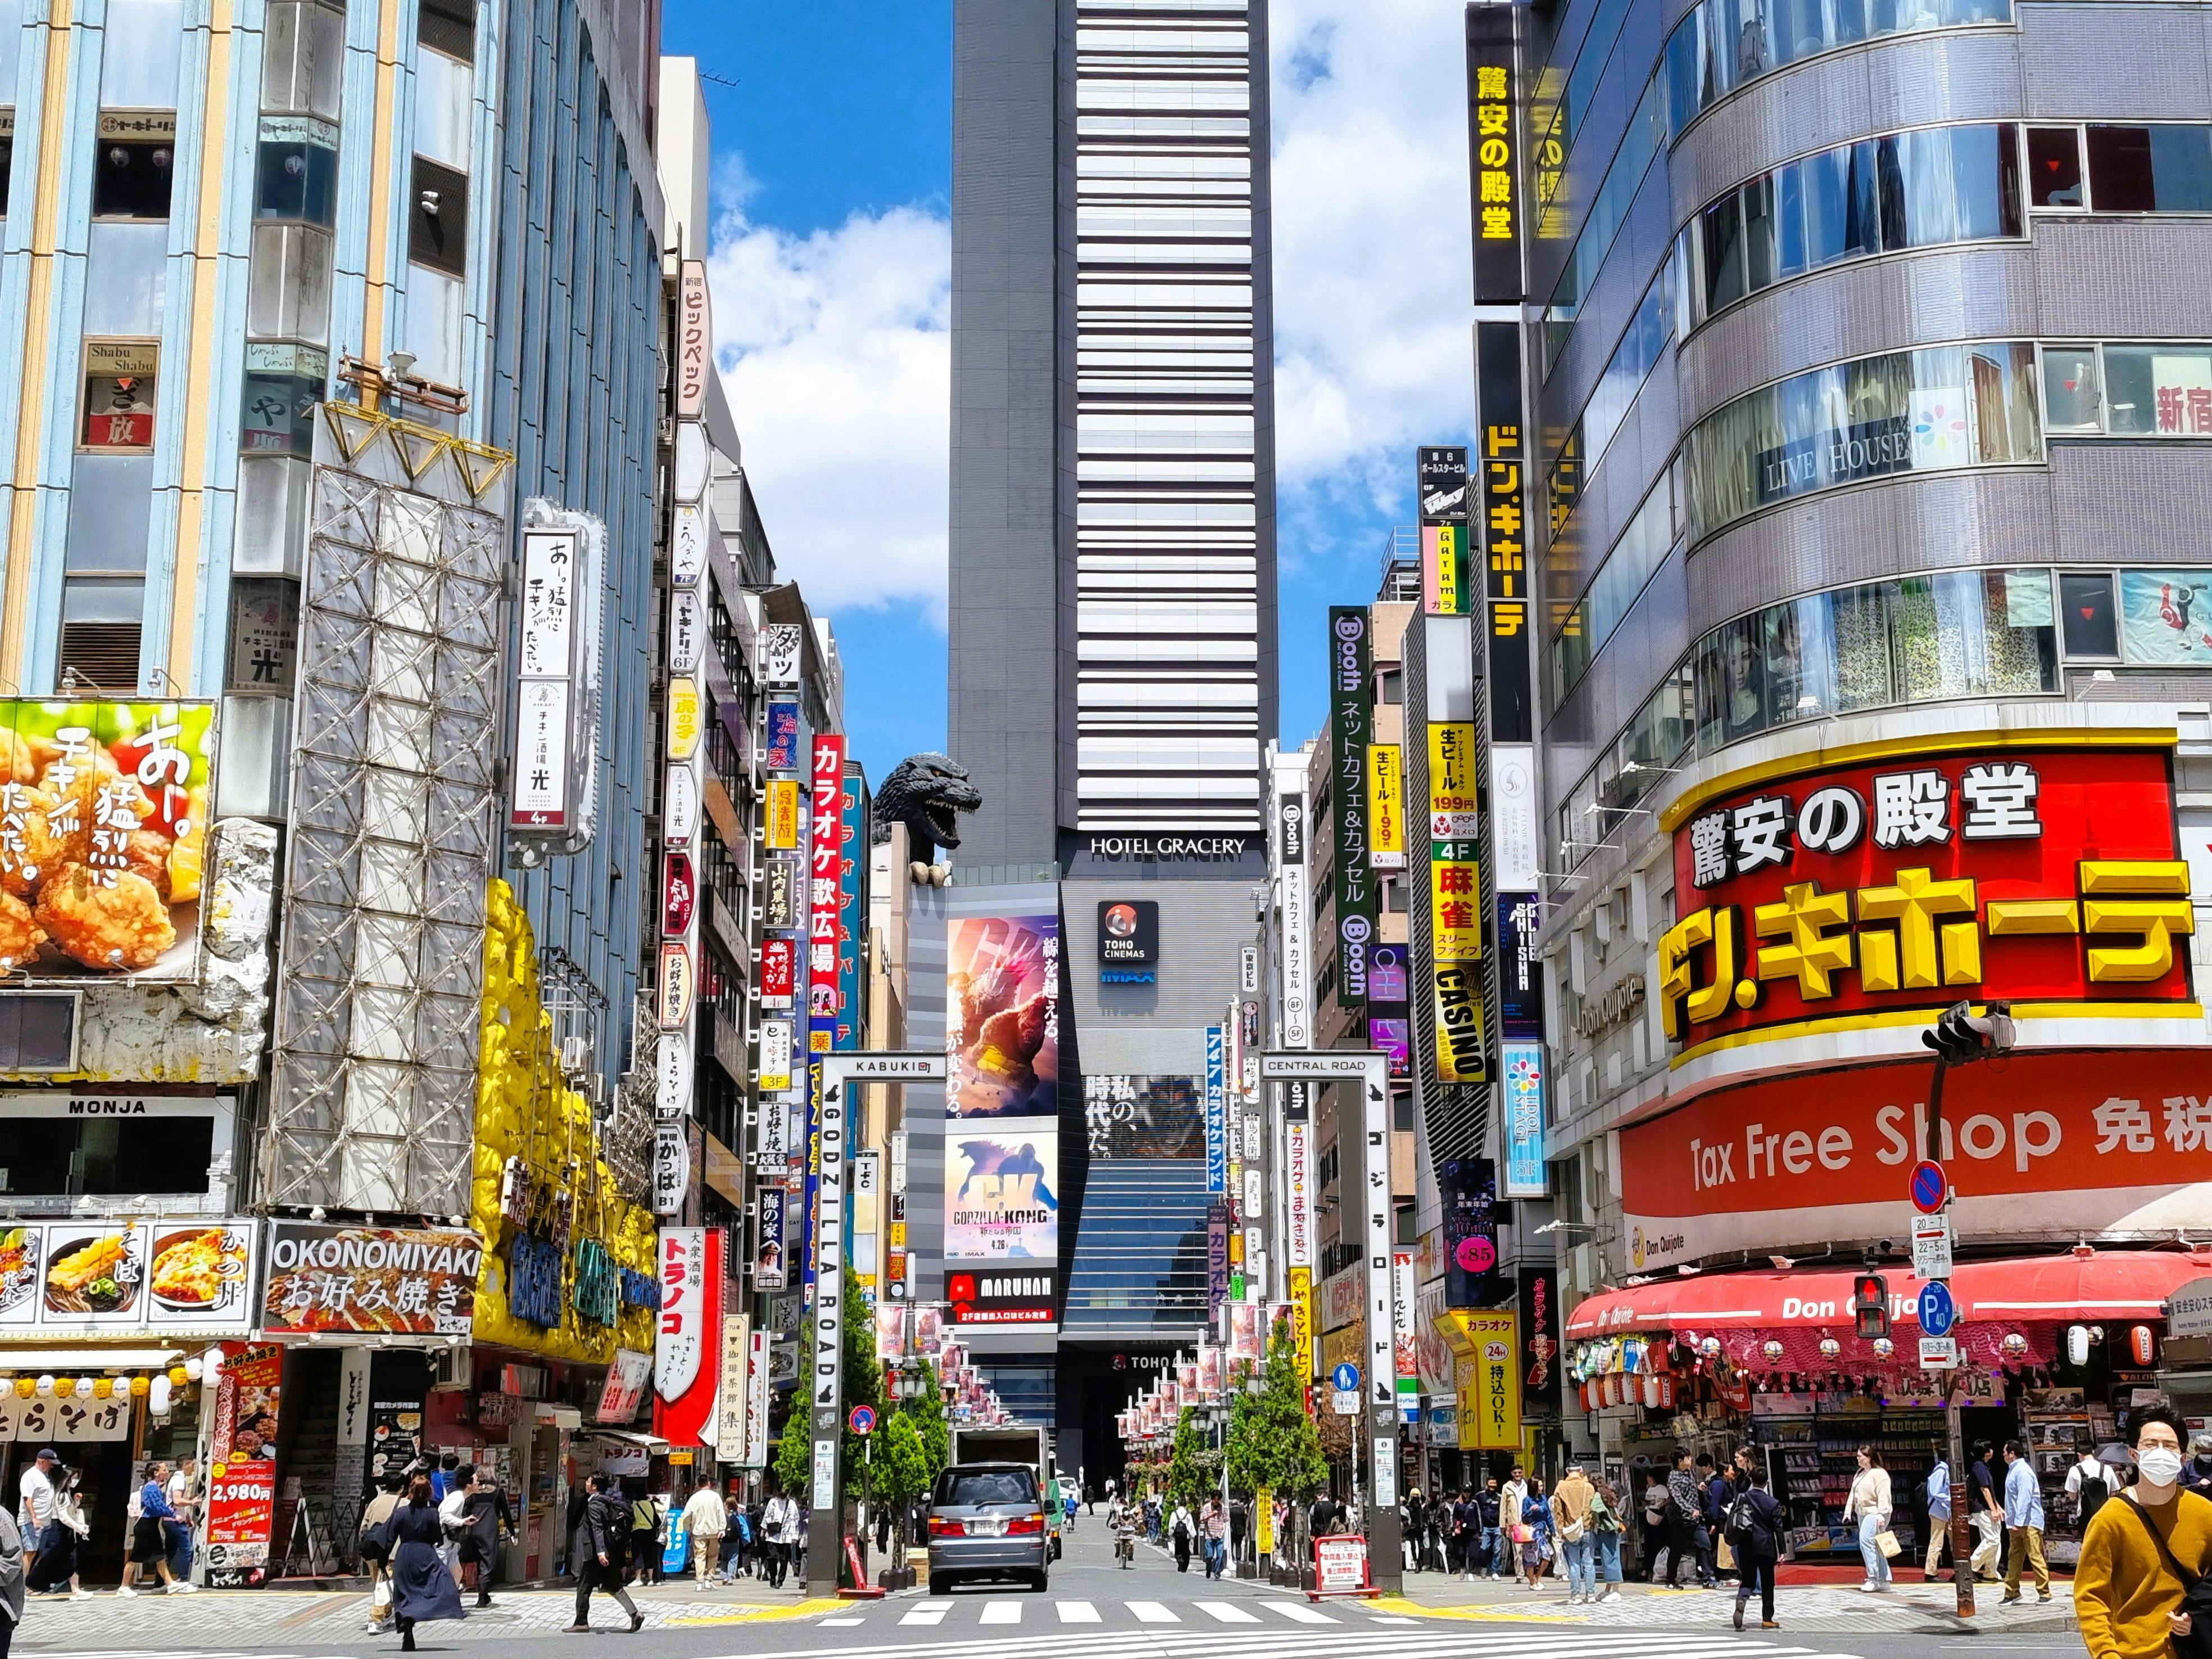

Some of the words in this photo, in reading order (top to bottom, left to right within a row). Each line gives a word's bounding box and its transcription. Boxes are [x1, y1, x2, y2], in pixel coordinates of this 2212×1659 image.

[1477, 66, 1512, 238] 驚安の殿堂
[685, 277, 702, 287] 新宿
[92, 346, 130, 358] Shabu
[115, 360, 153, 371] Shabu
[683, 293, 703, 399] ピックペック
[251, 395, 287, 427] や
[1766, 451, 1815, 492] LIVE
[1829, 432, 1909, 474] HOUSE
[1440, 532, 1455, 595] Garam
[1431, 600, 1462, 610] ガラム
[678, 606, 692, 649] ヤキトリ
[251, 649, 283, 684] 光
[526, 630, 543, 673] たべたい。
[674, 657, 693, 668] 6F
[774, 628, 795, 677] ダーツ
[674, 700, 696, 739] 虎の子
[767, 713, 797, 768] 海の家
[132, 714, 191, 838] あー。
[531, 769, 550, 790] 光
[1376, 751, 1389, 801] 生ビール
[1440, 729, 1456, 791] 生ビール
[47, 727, 90, 838] チキンが
[1341, 701, 1366, 902] ネットカフェ&カプセル
[1433, 796, 1474, 810] 199円
[1, 780, 38, 881] たべたい。
[89, 782, 143, 889] 猛烈に
[531, 811, 548, 824] 4F
[1380, 804, 1391, 847] 199円
[1690, 762, 2043, 888] 驚安の殿堂
[812, 744, 838, 973] カラオケ歌広場
[1091, 838, 1153, 854] HOTEL
[1157, 838, 1246, 854] GRACERY
[1440, 844, 1468, 860] 4F
[769, 864, 788, 918] 山内農場
[1439, 866, 1474, 929] 麻雀
[1104, 940, 1134, 949] TOHO
[1341, 914, 1371, 996] Booth
[1436, 945, 1479, 956] ファイブ
[1437, 935, 1468, 944] スリー
[668, 957, 681, 1017] お好み焼き
[1245, 954, 1254, 988] 東京ビル
[768, 998, 783, 1008] 4F
[1435, 968, 1484, 1075] CASINO
[1581, 1007, 1602, 1040] Don
[811, 1032, 831, 1050] 薬
[667, 1051, 679, 1105] とらそば
[767, 1076, 782, 1087] 3F
[1268, 1061, 1327, 1071] CENTRAL
[1331, 1061, 1366, 1070] ROAD
[69, 1100, 146, 1114] MONJA
[661, 1108, 675, 1117] 1F
[764, 1103, 781, 1152] お好み焼
[1514, 1096, 1527, 1146] STAGE
[1526, 1096, 1538, 1137] IDOL
[1292, 1135, 1304, 1184] カラオケ
[1690, 1138, 1736, 1193] Tax
[1746, 1123, 1853, 1180] Free
[1875, 1103, 2062, 1173] Shop
[2091, 1096, 2212, 1154] 免税
[658, 1142, 677, 1191] かっぱ
[1517, 1161, 1538, 1177] 5F
[658, 1196, 673, 1207] B1
[820, 1108, 842, 1275] GODZILLA
[763, 1193, 779, 1239] 海の家
[1293, 1195, 1306, 1263] まねきねこ
[1456, 1222, 1494, 1233] 10min
[18, 1230, 37, 1295] とんかつ
[114, 1231, 140, 1283] そば
[273, 1239, 482, 1277] OKONOMIYAKI
[688, 1231, 702, 1288] 大衆酒場
[991, 1239, 1005, 1250] 4.26
[1368, 1130, 1388, 1354] ゴジラロード
[1646, 1240, 1659, 1257] Don
[1660, 1234, 1685, 1254] Quijote
[660, 1238, 687, 1335] トラノコ
[891, 1258, 903, 1277] 麻雀
[981, 1277, 1051, 1297] MARUHAN
[281, 1273, 461, 1315] お好み焼き
[1395, 1299, 1406, 1329] 九十九
[1533, 1277, 1545, 1332] カラオケ
[1783, 1298, 1835, 1319] Don
[1924, 1294, 1938, 1329] P
[818, 1295, 837, 1376] ROAD
[1466, 1320, 1512, 1332] カラオケ
[677, 1335, 696, 1377] やきとり
[1131, 1357, 1169, 1368] TOHO
[1488, 1345, 1506, 1357] 24H
[727, 1350, 739, 1404] 珈琲茶館
[723, 1412, 740, 1429] 集
[1490, 1365, 1507, 1438] 持込OK!
[604, 1447, 643, 1459] トラノコ
[212, 1483, 270, 1503] 2,980円
